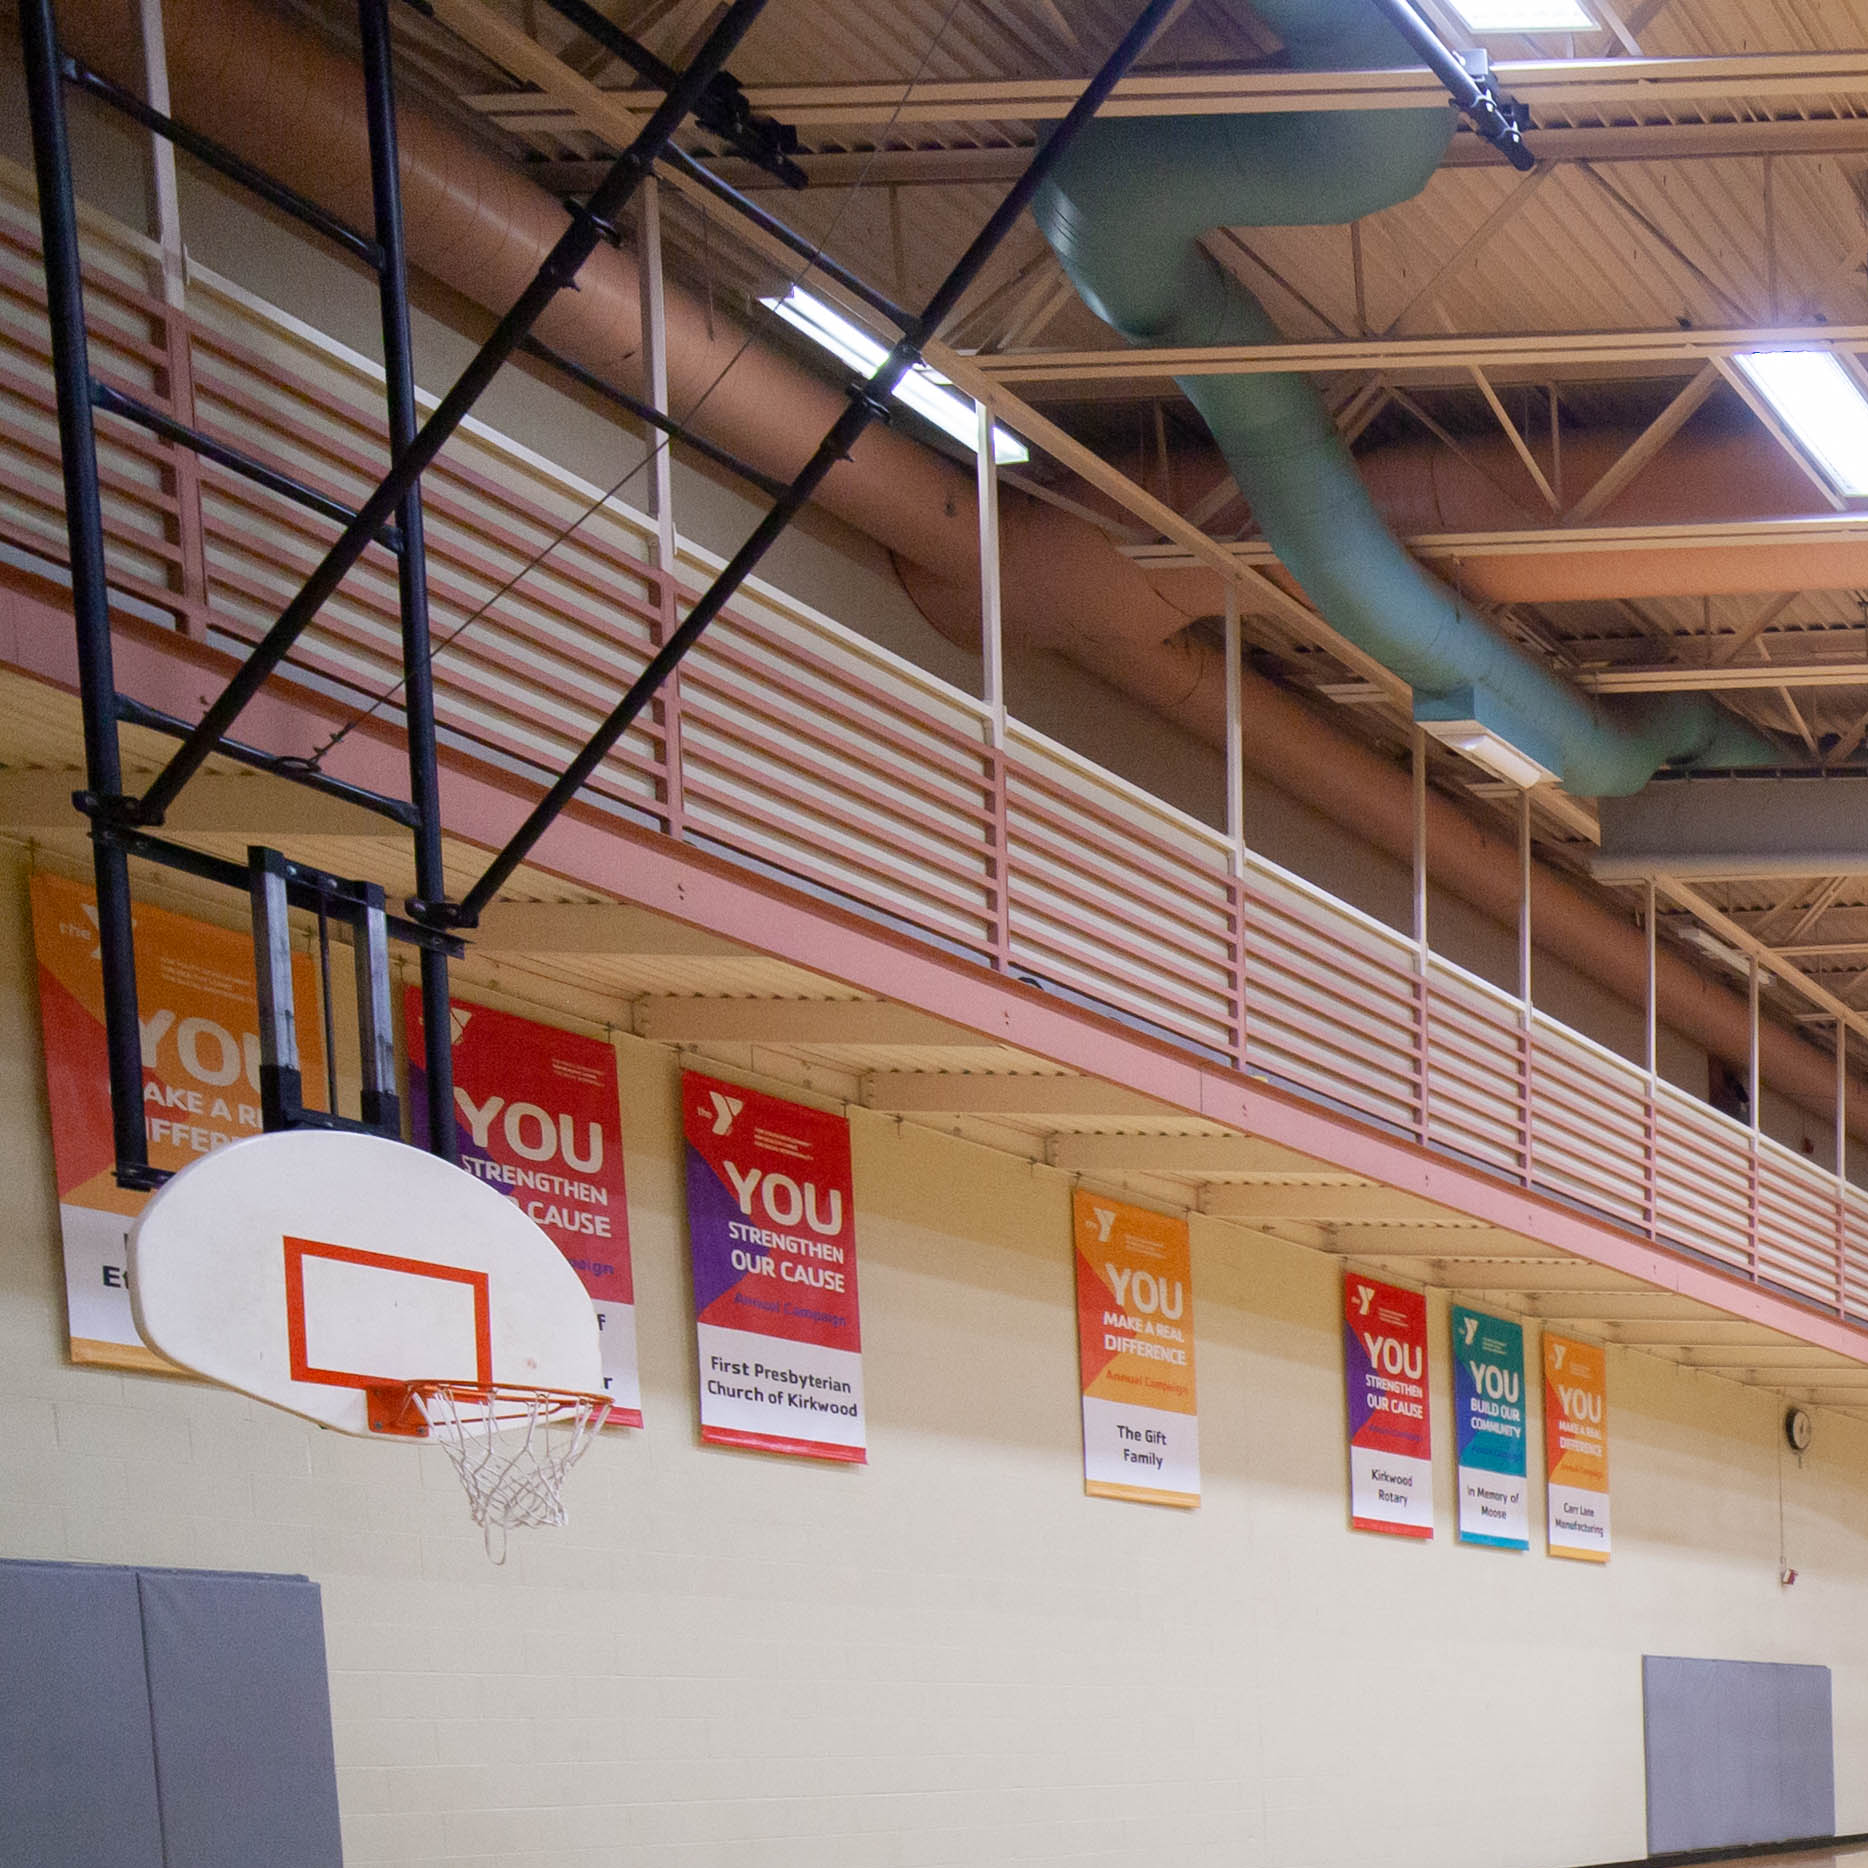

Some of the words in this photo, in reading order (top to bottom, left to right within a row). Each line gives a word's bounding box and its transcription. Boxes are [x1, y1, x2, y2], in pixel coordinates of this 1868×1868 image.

[143, 1080, 203, 1112] AKE
[211, 1098, 232, 1121] A
[453, 1086, 604, 1174] YOU
[461, 1154, 608, 1207] STRENGTHEN
[723, 1160, 842, 1236] YOU
[528, 1201, 612, 1238] CAUSE
[728, 1221, 844, 1264] STRENGTHEN
[731, 1250, 776, 1278] OUR
[780, 1262, 845, 1293] CAUSE
[1105, 1262, 1183, 1321] YOU
[1103, 1311, 1143, 1332] MAKE
[1145, 1321, 1156, 1336] A
[1156, 1323, 1185, 1343] REAL
[1104, 1334, 1188, 1366] DIFFERENCE
[1363, 1331, 1423, 1380] YOU
[711, 1356, 750, 1376] First
[754, 1363, 851, 1393] Presbyterian
[1365, 1374, 1424, 1398] STRENGTHEN
[1469, 1360, 1519, 1404] YOU
[707, 1379, 764, 1402] Church
[768, 1391, 784, 1404] of
[788, 1393, 858, 1417] Kirkwood
[1367, 1393, 1389, 1412] OUR
[1391, 1400, 1424, 1420] CAUSE
[1470, 1397, 1499, 1417] BUILD
[1500, 1405, 1521, 1422] OUR
[1558, 1386, 1602, 1423] YOU
[1117, 1424, 1141, 1441] The
[1145, 1429, 1168, 1446] Gift
[1470, 1416, 1522, 1439] COMMUNITY
[1123, 1448, 1163, 1470] Family
[1371, 1468, 1413, 1487] Kirkwood
[1378, 1489, 1408, 1508] Rotary
[1477, 1487, 1508, 1505] Memory
[1510, 1493, 1520, 1504] of
[1481, 1505, 1507, 1520] Moose
[1555, 1518, 1604, 1538] Manufacturing
